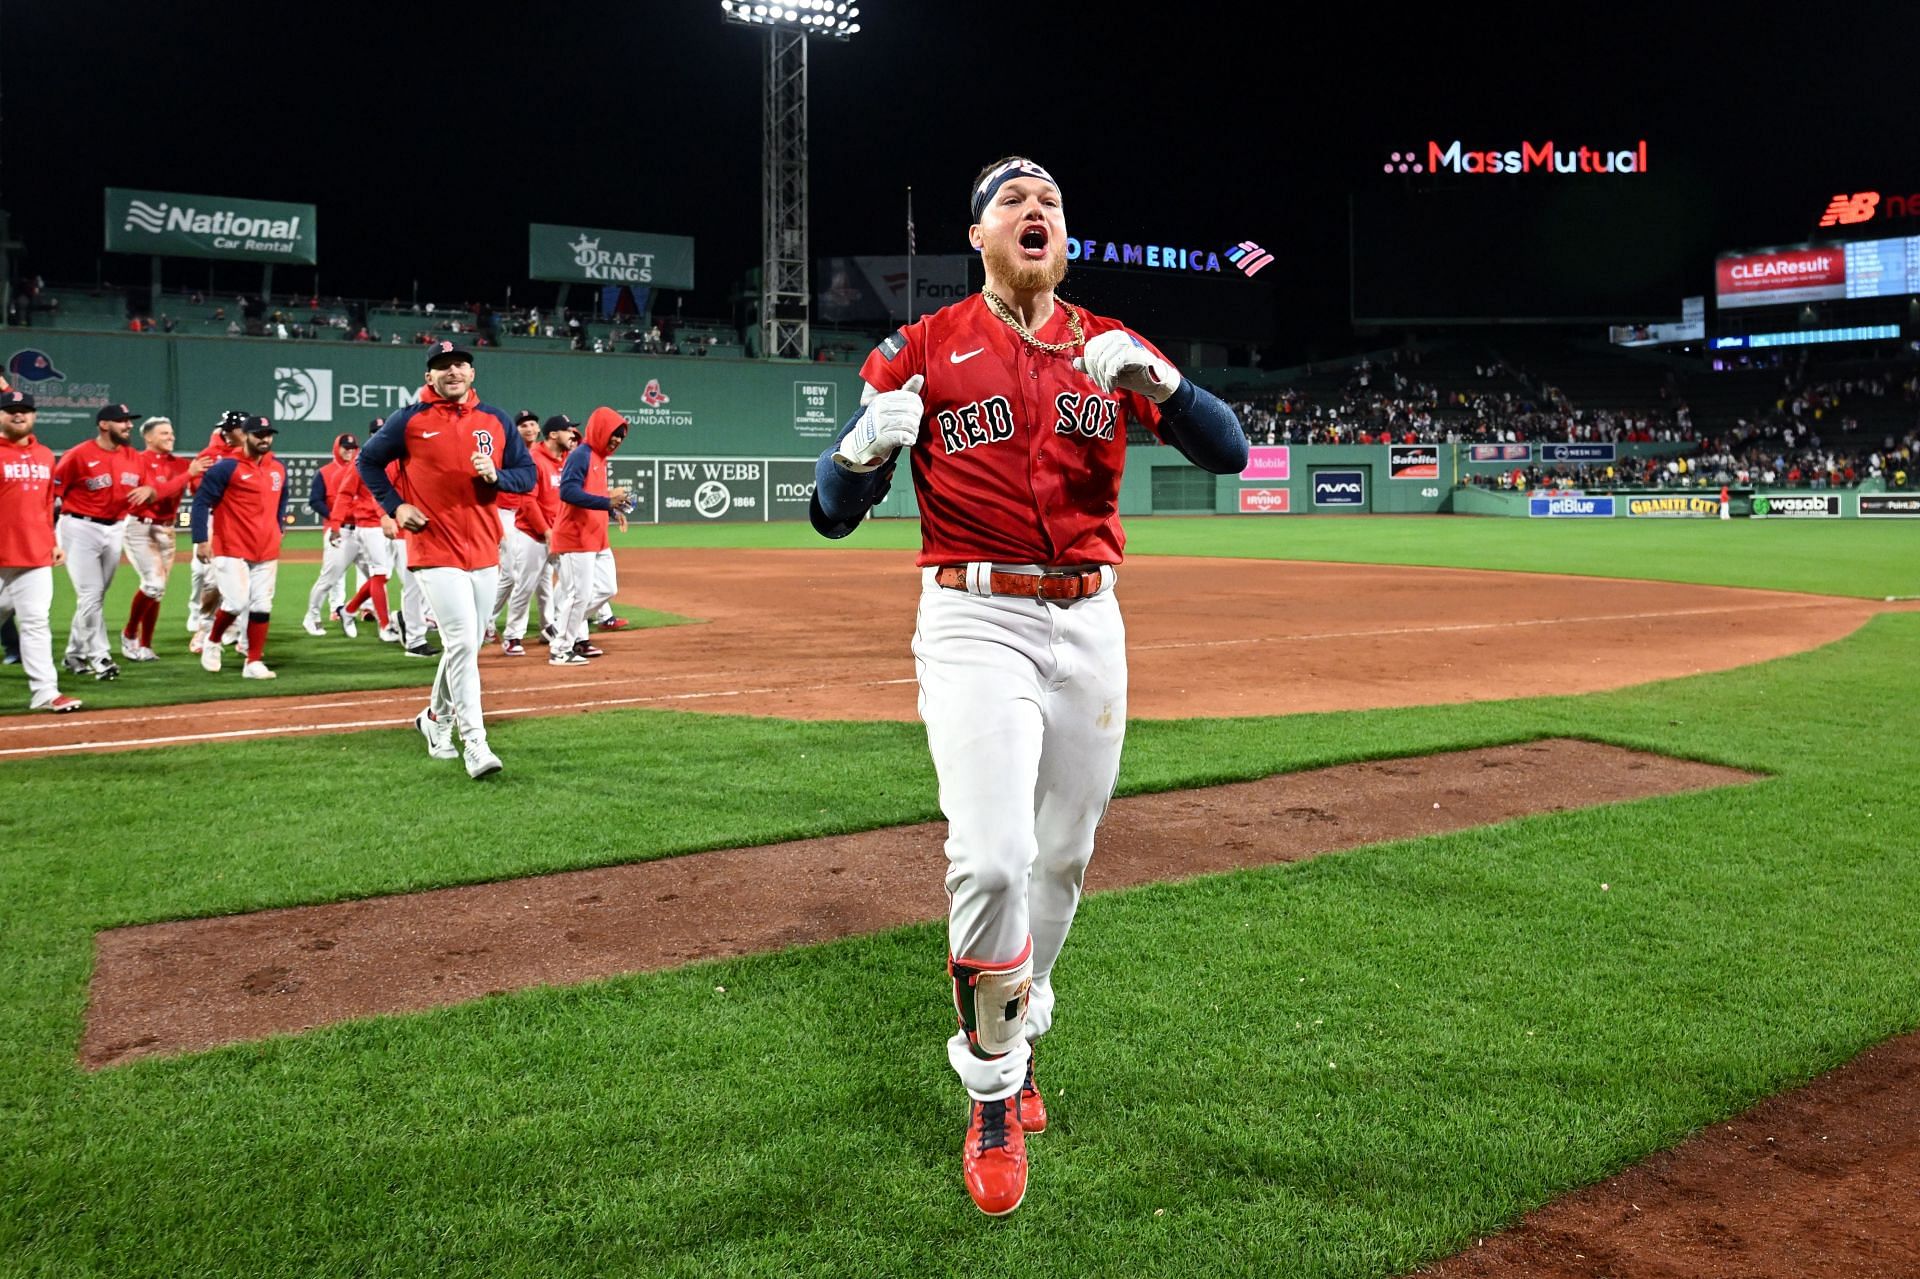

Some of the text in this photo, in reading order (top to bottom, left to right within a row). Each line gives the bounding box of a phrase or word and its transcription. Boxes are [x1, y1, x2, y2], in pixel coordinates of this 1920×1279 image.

[1428, 140, 1647, 173] MassMutual
[166, 206, 300, 240] National
[213, 237, 294, 253] Car Rental
[574, 249, 655, 267] DRAFT
[1067, 237, 1221, 272] OF AMERICA
[585, 263, 652, 283] KINGS
[1731, 257, 1830, 279] CLEAResult
[802, 386, 828, 396] IBEW
[807, 397, 825, 406] 103
[937, 395, 1015, 454] RED
[1055, 392, 1120, 441] SOX
[1392, 456, 1437, 465] Safelite
[703, 464, 760, 481] WEBB
[1247, 495, 1281, 505] IRVING
[1421, 488, 1438, 497] 420
[665, 497, 691, 508] Since
[733, 497, 755, 508] 1866
[1549, 500, 1594, 514] jetBlue
[1631, 497, 1719, 515] GRANITE CITY
[1770, 496, 1828, 511] wasabi
